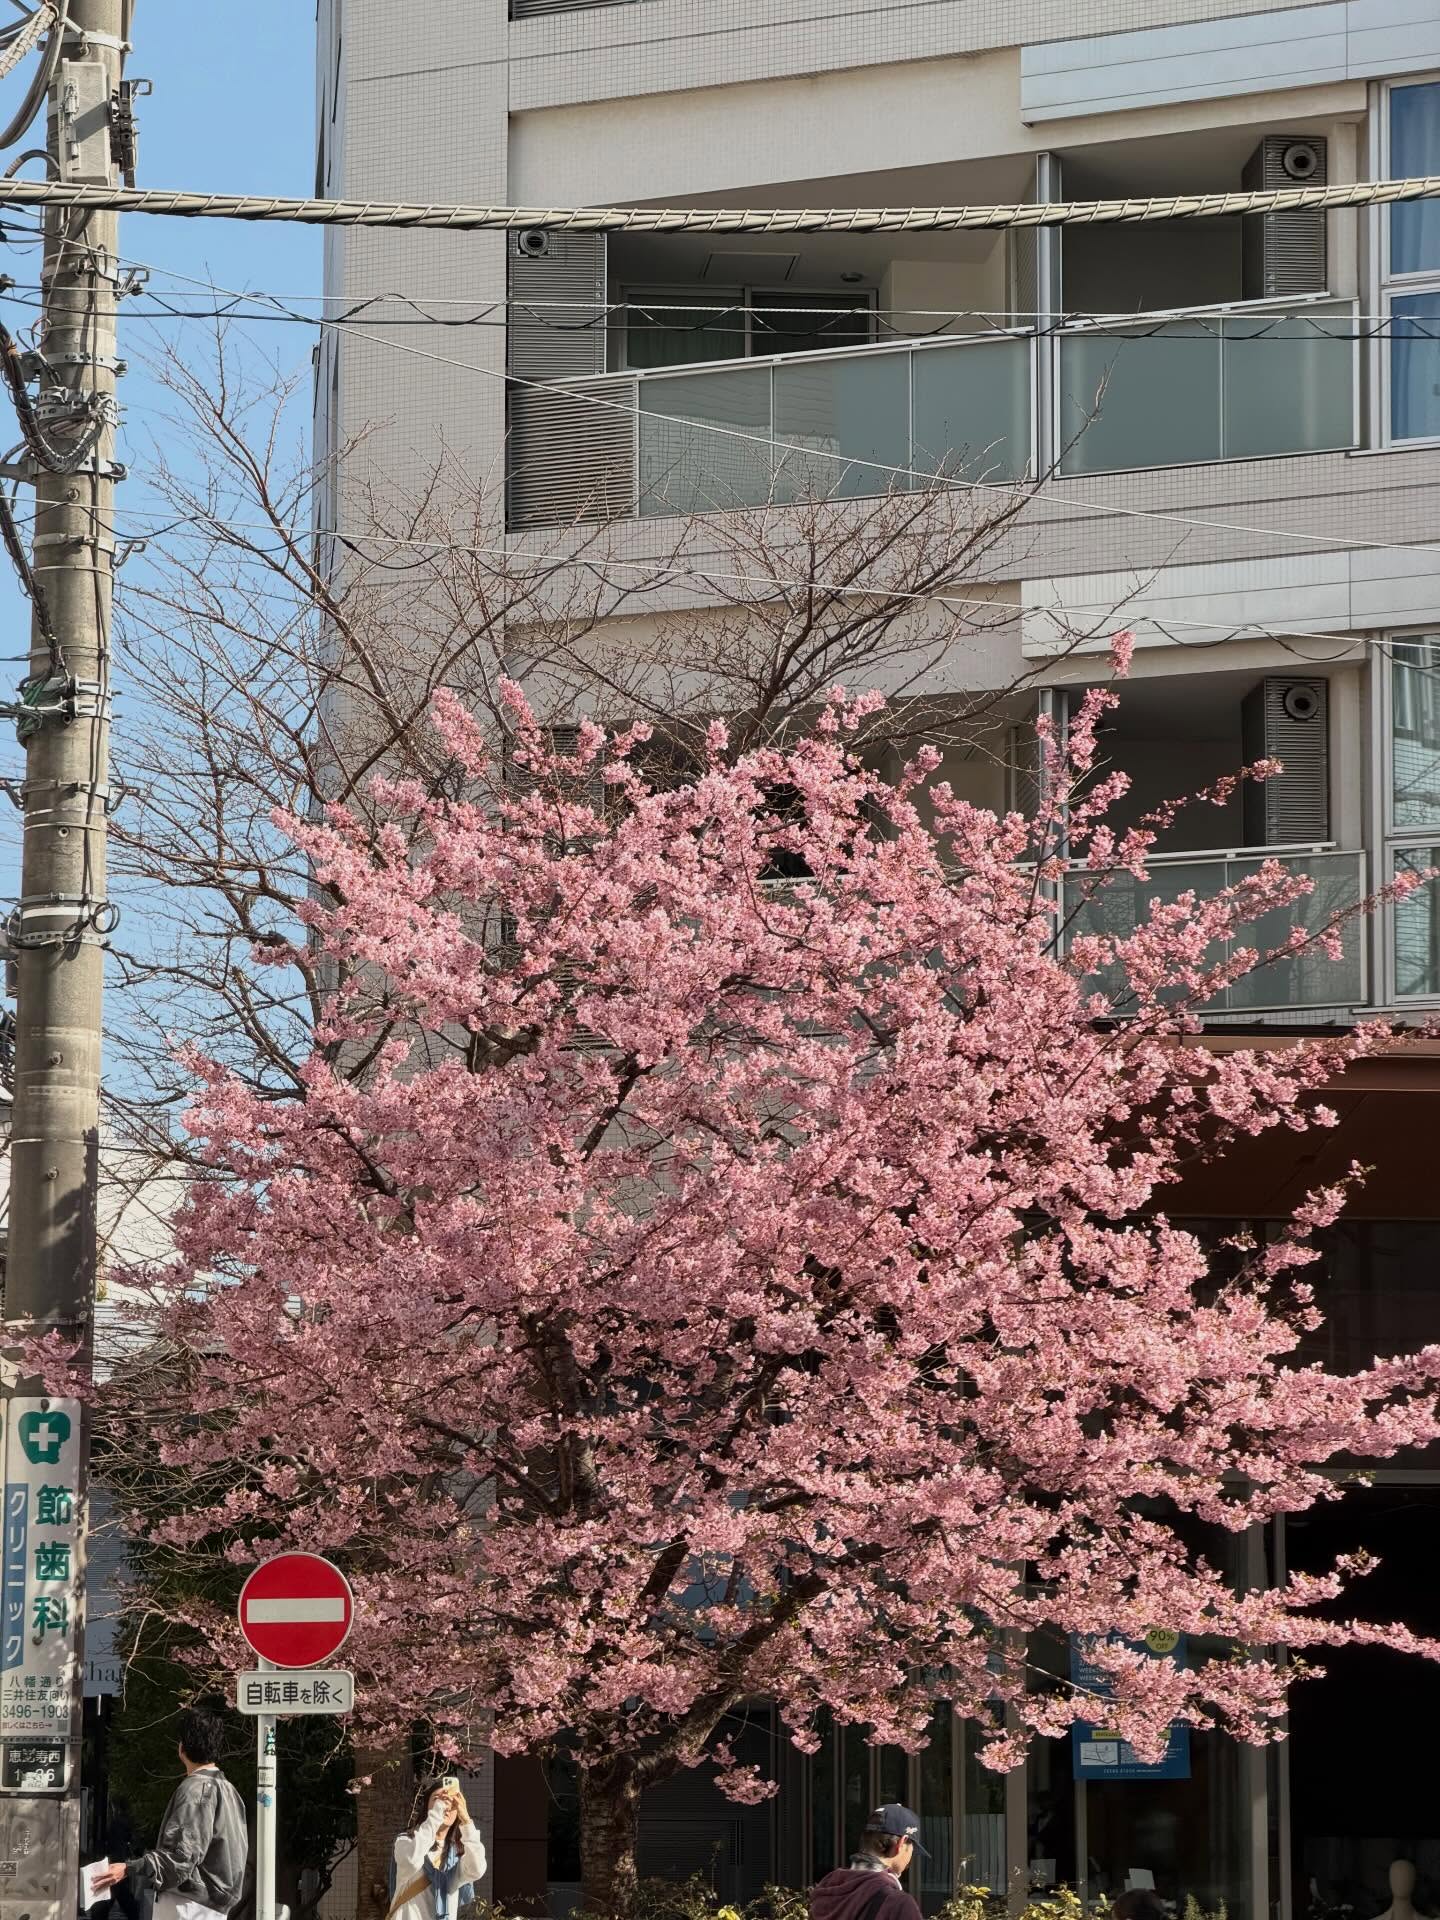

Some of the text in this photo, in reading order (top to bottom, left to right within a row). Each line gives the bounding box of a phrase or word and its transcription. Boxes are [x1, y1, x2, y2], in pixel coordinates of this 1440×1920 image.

[32, 1484, 73, 1638] 節歯科
[5, 1489, 26, 1663] クリニック
[9, 1675, 65, 1688] 八幡通り
[3, 1689, 69, 1702] 三井住友向い
[246, 1680, 343, 1706] 自転車を除く
[2, 1704, 69, 1719] 3496-1903
[14, 1768, 56, 1782] 16
